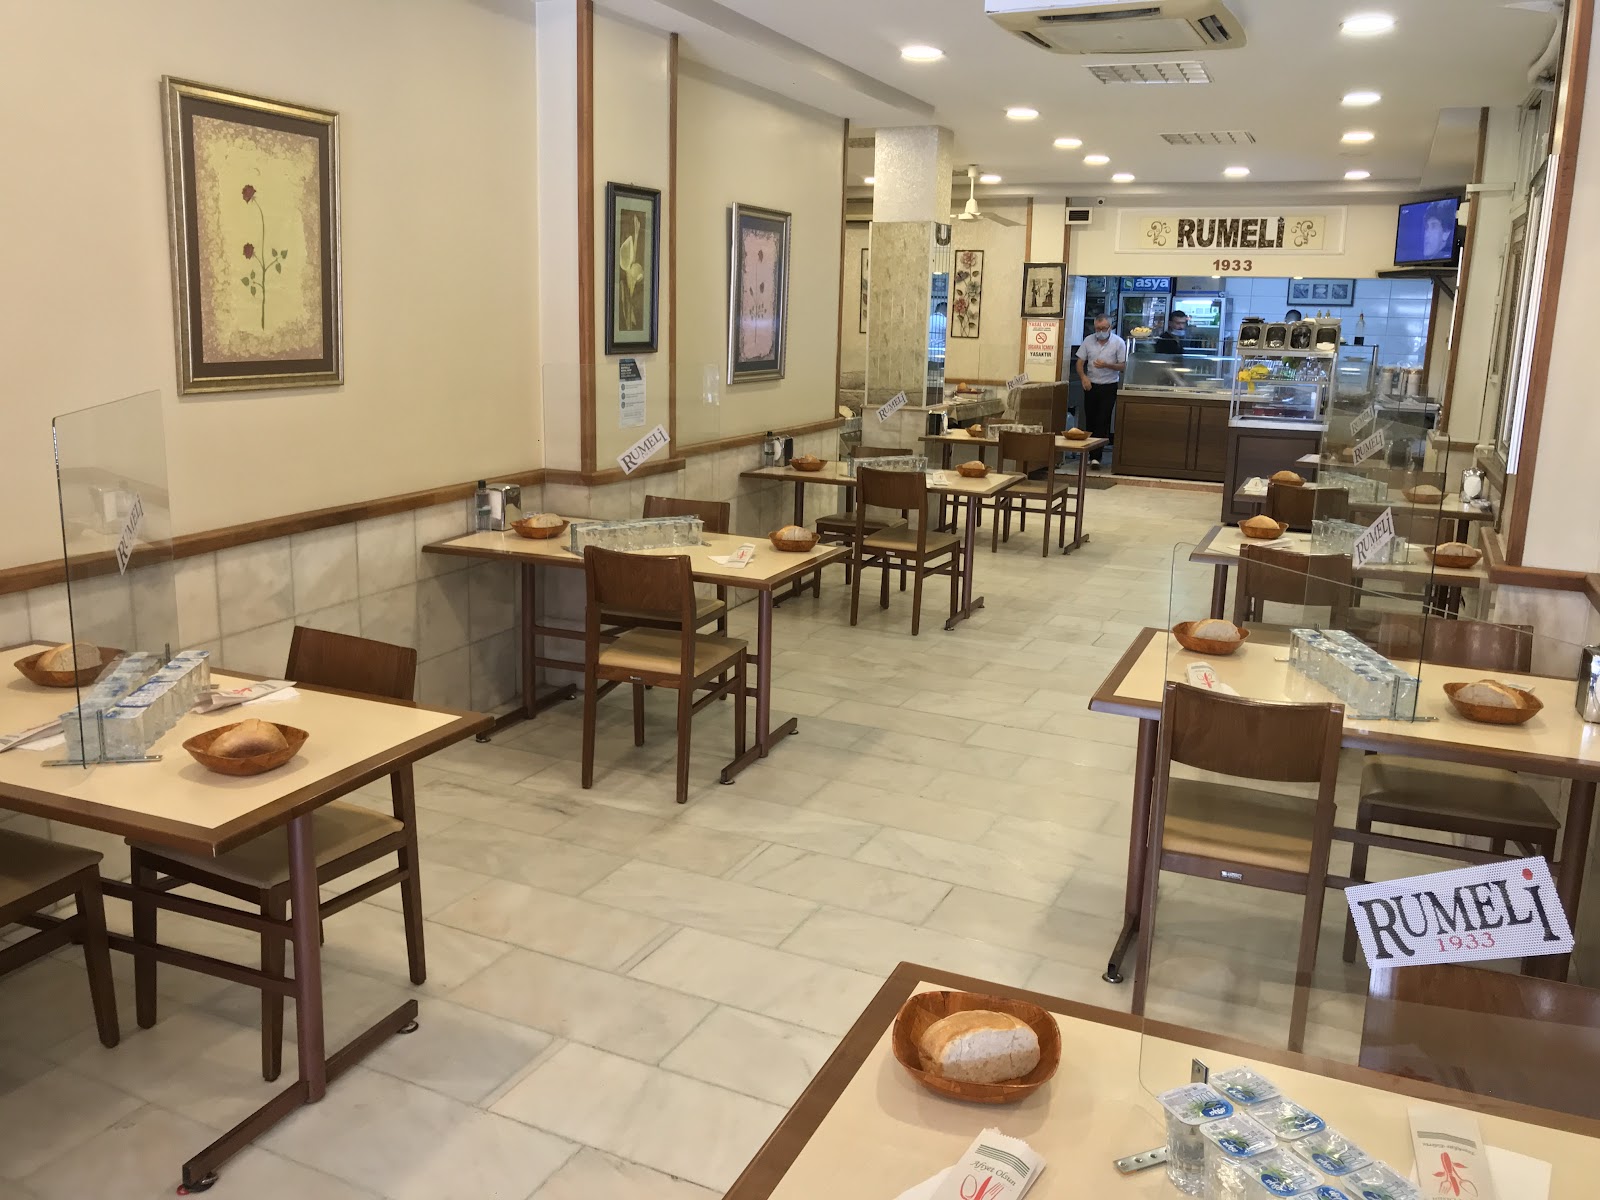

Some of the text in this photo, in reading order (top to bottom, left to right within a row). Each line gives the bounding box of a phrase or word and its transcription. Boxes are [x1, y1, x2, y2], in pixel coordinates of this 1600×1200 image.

[1213, 259, 1253, 271] 1933
[1135, 278, 1169, 290] asya
[1437, 932, 1496, 952] 1933
[970, 1160, 1016, 1187] Afiyet Olsun
